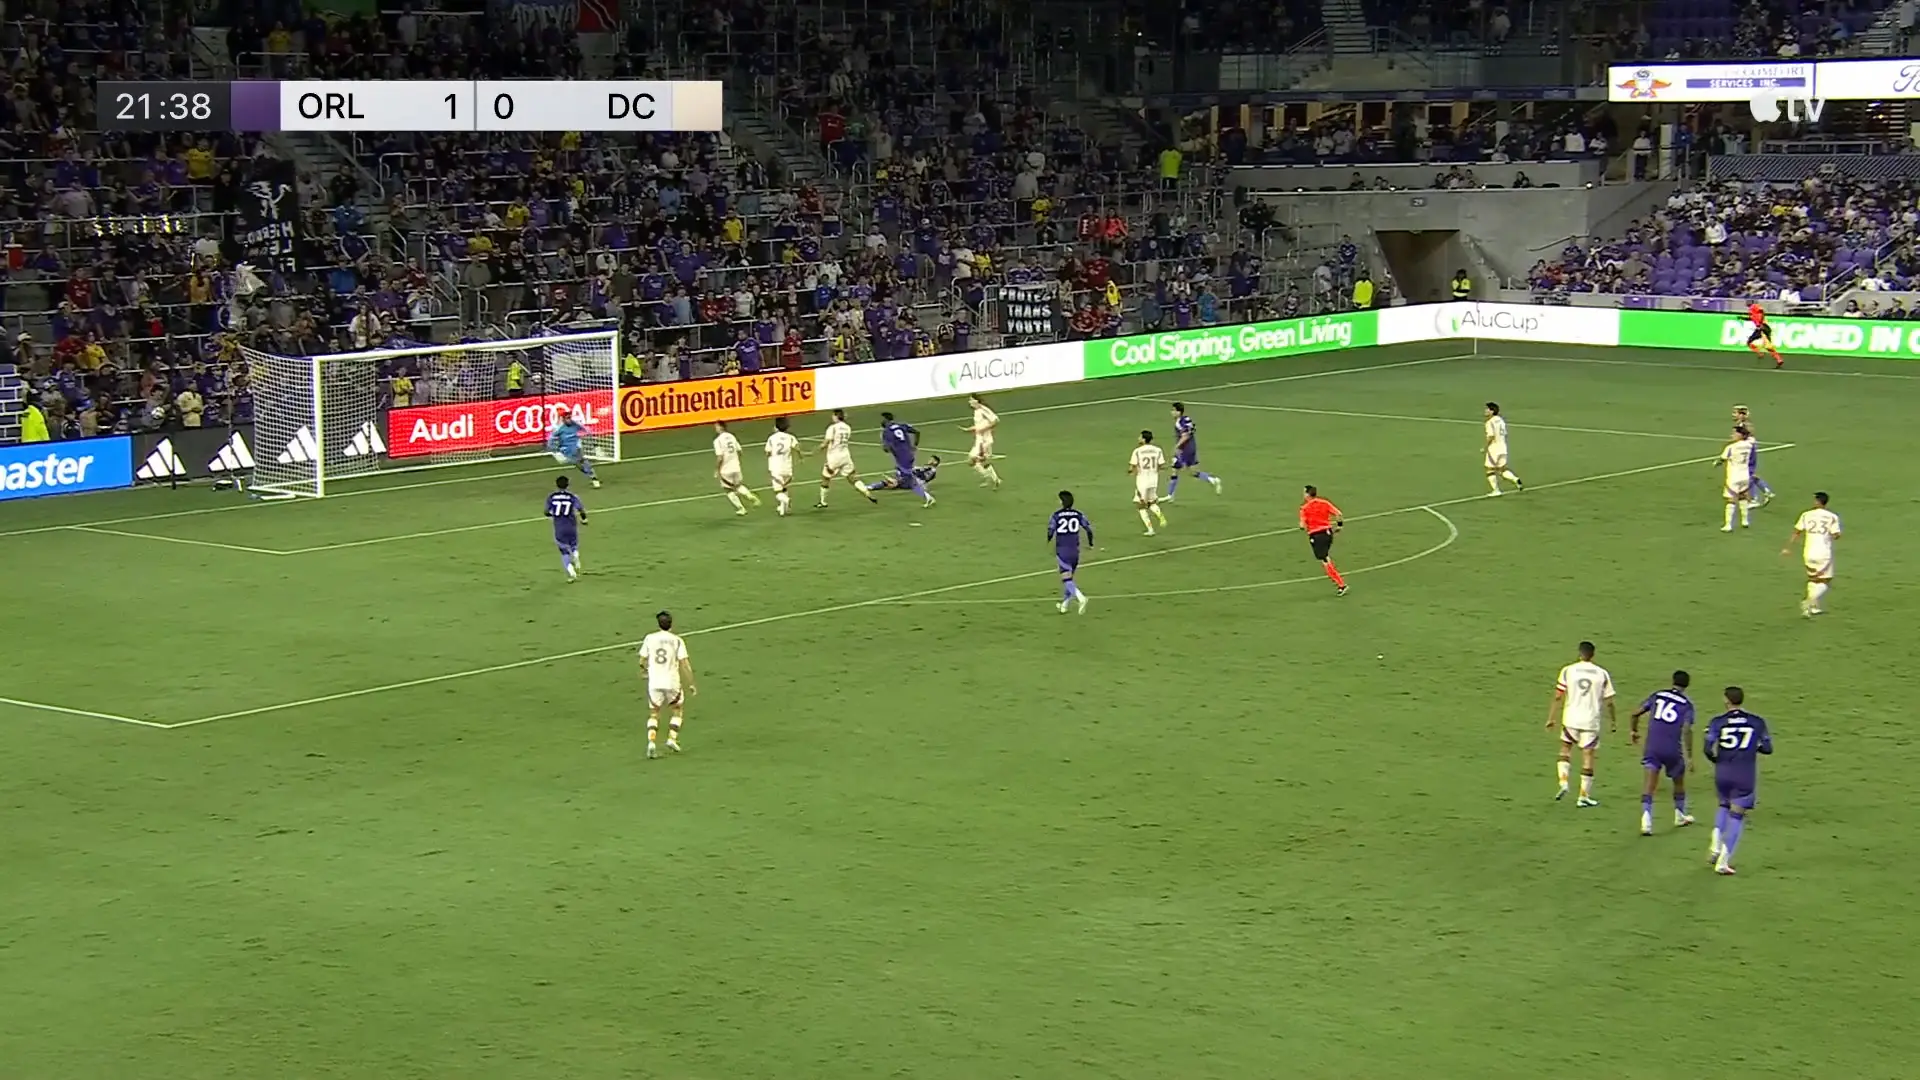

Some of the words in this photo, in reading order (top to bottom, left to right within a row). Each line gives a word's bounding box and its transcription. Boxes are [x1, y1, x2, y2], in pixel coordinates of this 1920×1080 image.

[1709, 78, 1754, 89] SERVICES
[1007, 319, 1052, 334] YOUTH
[1460, 311, 1540, 333] AluCup
[1110, 336, 1157, 368] Cool
[1159, 332, 1237, 366] Sipping,
[1239, 325, 1296, 353] Green
[1299, 317, 1353, 347] Living
[1869, 325, 1903, 353] IN
[959, 358, 1026, 382] AluCup
[620, 389, 744, 427] Continental
[763, 376, 813, 405] Tire
[409, 413, 475, 444] Audi
[893, 428, 904, 441] 9
[776, 443, 785, 455] 2
[1142, 456, 1156, 470] 21
[551, 500, 572, 516] 77
[1056, 517, 1080, 533] 20
[1807, 519, 1829, 535] 23
[655, 648, 667, 665] 8
[1578, 678, 1593, 697] 9
[1654, 698, 1679, 723] 16
[1719, 727, 1755, 750] 57
